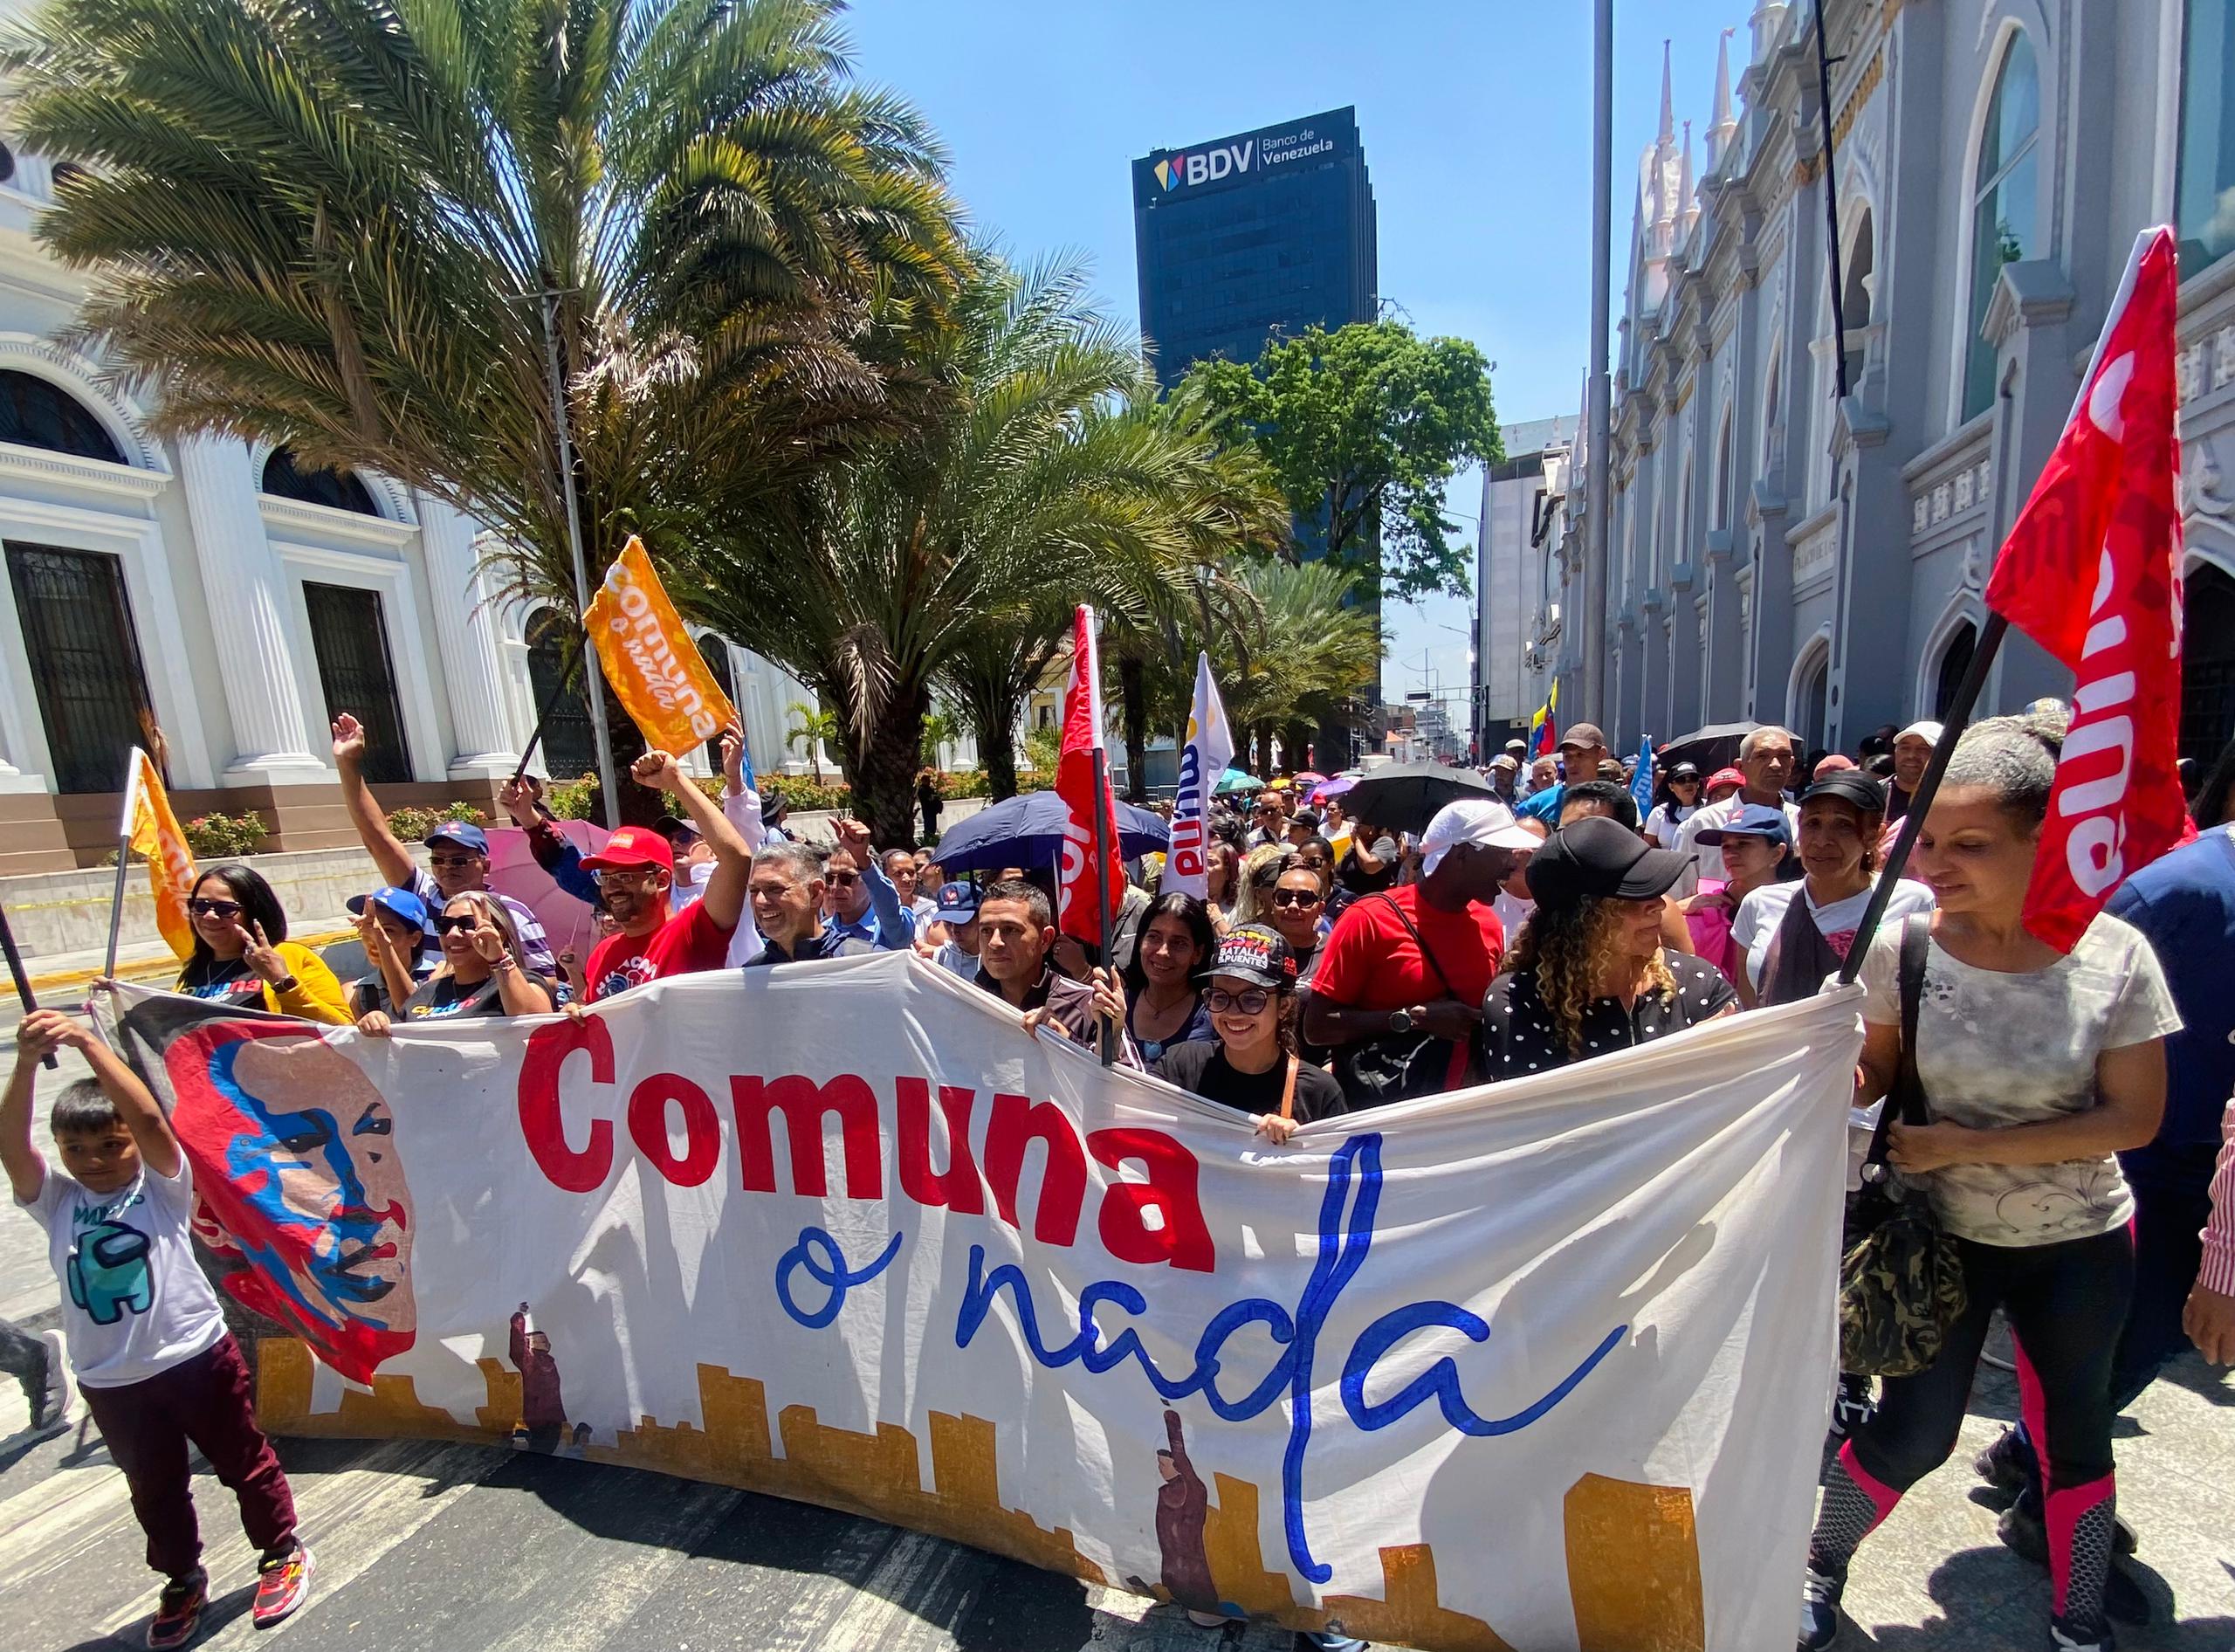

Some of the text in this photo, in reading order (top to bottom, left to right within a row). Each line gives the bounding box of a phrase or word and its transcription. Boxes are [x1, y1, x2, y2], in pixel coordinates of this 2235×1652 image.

[1262, 128, 1315, 151] Banco de
[1262, 139, 1334, 165] Venezuela
[1186, 141, 1254, 186] BDV
[1220, 946, 1268, 962] BATALLA
[518, 1012, 1216, 1273] Comuna
[775, 1132, 1630, 1585] o nada
